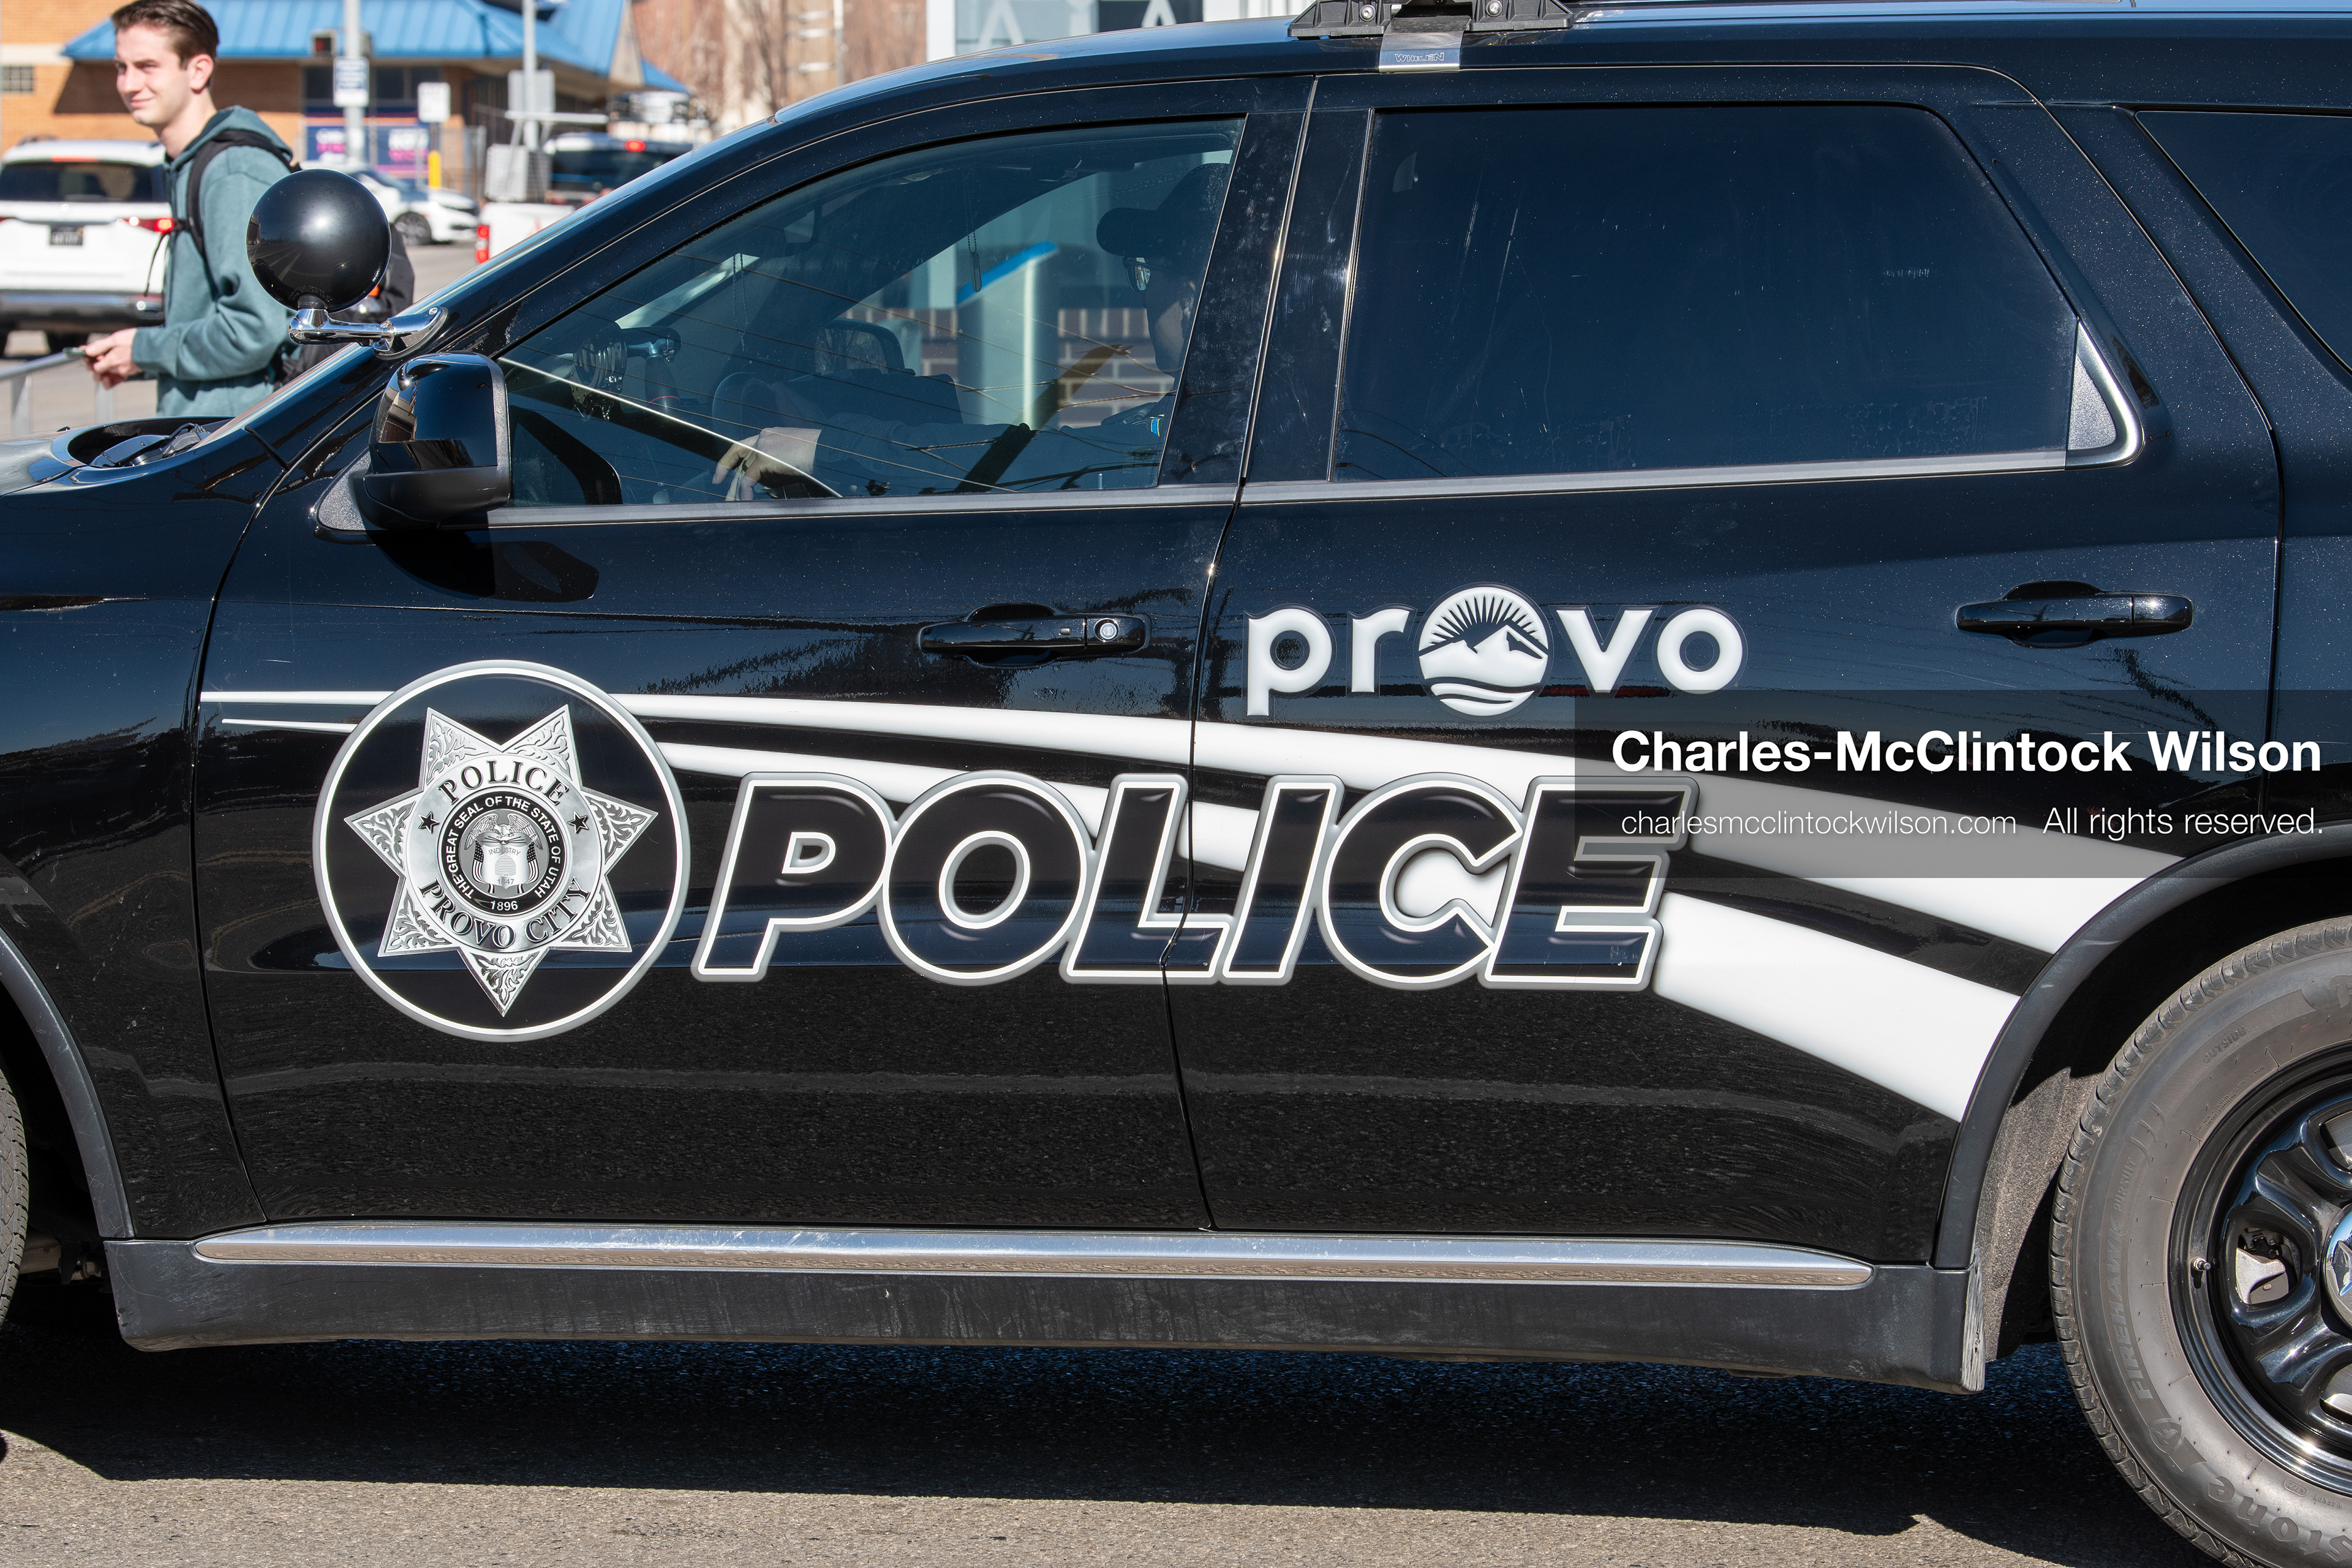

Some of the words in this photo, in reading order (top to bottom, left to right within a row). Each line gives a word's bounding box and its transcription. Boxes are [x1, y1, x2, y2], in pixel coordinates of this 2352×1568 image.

[1394, 52, 1445, 62] WHELEN
[1246, 586, 1744, 716] provo
[437, 760, 570, 806] POLICE
[454, 802, 484, 829] SEAL
[484, 796, 502, 807] OF
[505, 796, 531, 812] THE
[530, 807, 559, 843] STATE
[446, 829, 459, 873] GREAT
[488, 847, 521, 856] INDUSTRY
[551, 845, 562, 864] OF
[453, 874, 475, 899] THE
[534, 867, 560, 899] UTAH
[692, 771, 1699, 990] POLICE
[418, 877, 516, 948] PROVO
[524, 876, 590, 944] CITY
[490, 900, 519, 911] 1896
[2113, 1157, 2137, 1213] PURSUIT
[2106, 1215, 2154, 1401] FIREHAWK
